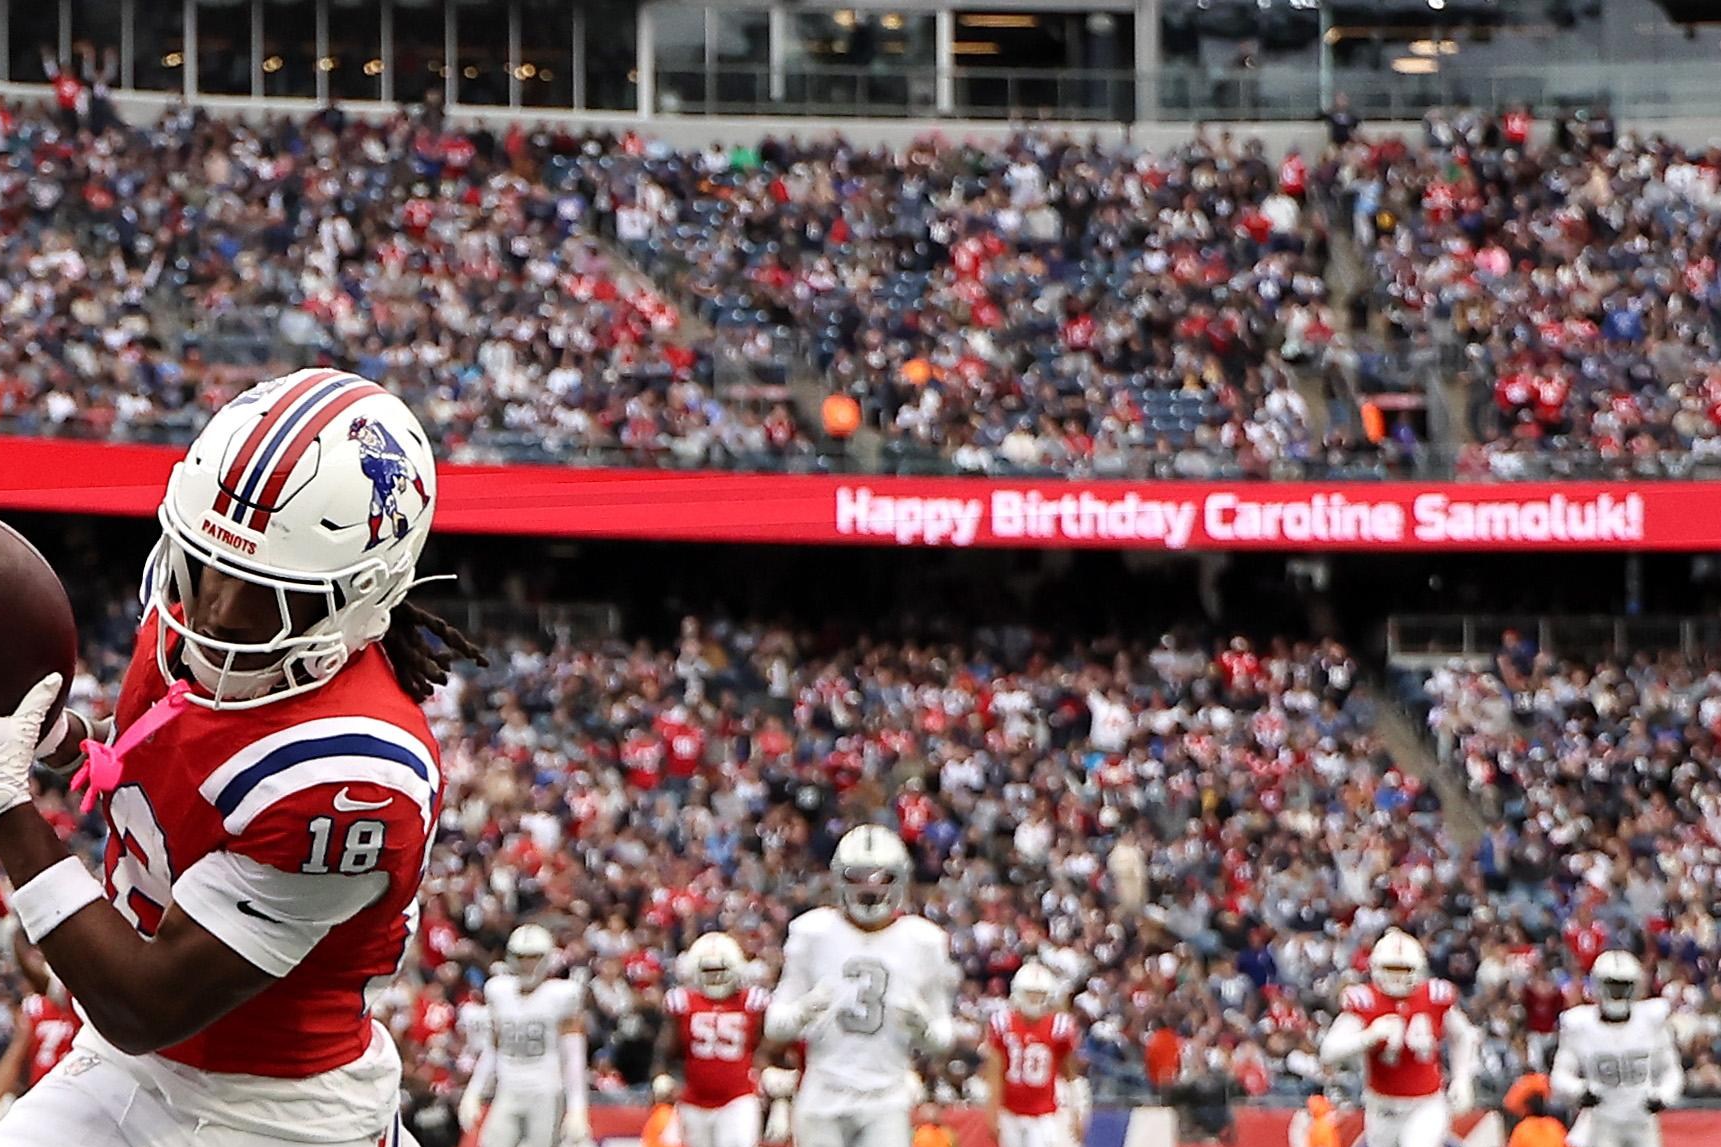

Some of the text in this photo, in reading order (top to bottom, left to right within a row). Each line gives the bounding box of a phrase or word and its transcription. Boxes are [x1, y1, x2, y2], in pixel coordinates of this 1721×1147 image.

[201, 518, 258, 555] PATRIOTS
[835, 486, 983, 546] Happy
[991, 489, 1196, 550] Birthday
[1203, 491, 1406, 543] Caroline
[301, 815, 386, 875] 18
[836, 955, 889, 1036] 3
[689, 1011, 747, 1062] 55
